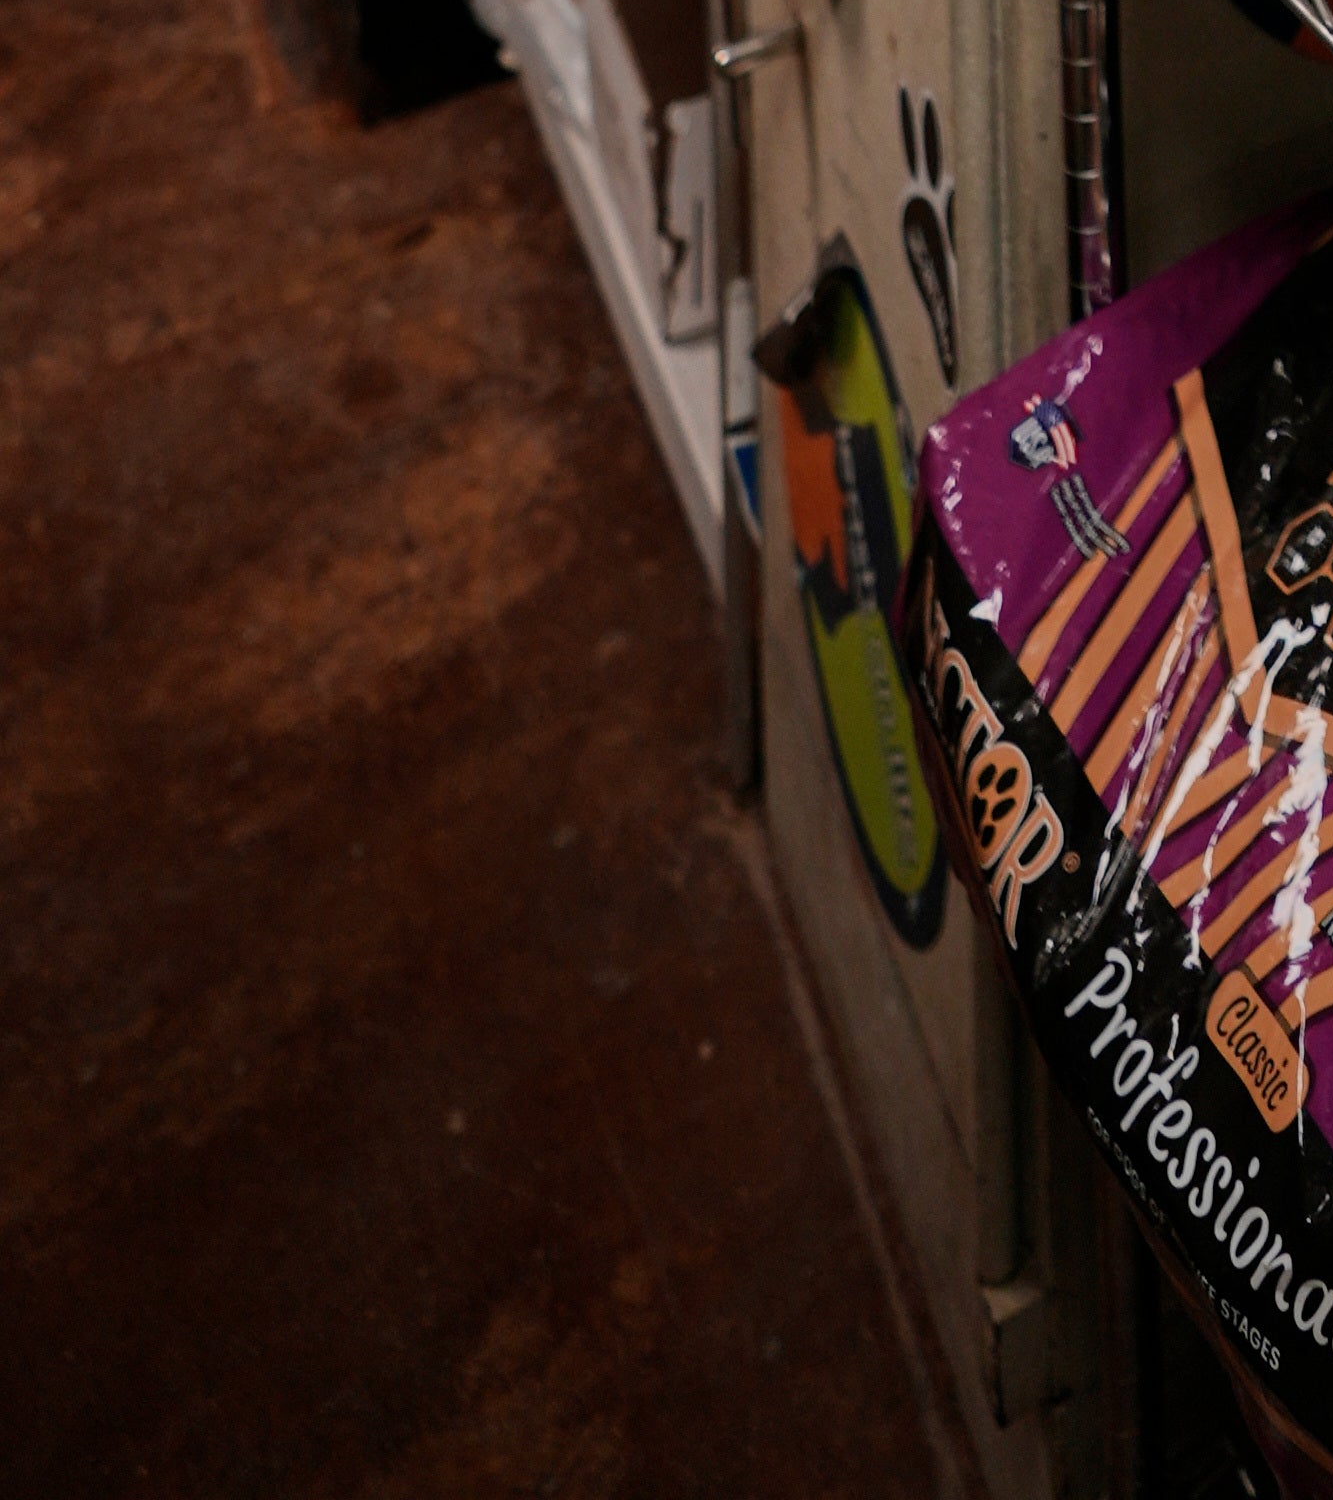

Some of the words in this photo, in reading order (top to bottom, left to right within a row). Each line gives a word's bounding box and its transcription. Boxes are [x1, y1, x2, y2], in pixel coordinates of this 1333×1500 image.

[1011, 419, 1054, 468] USA
[1214, 996, 1288, 1113] Classic
[1220, 1301, 1281, 1372] STAGES
